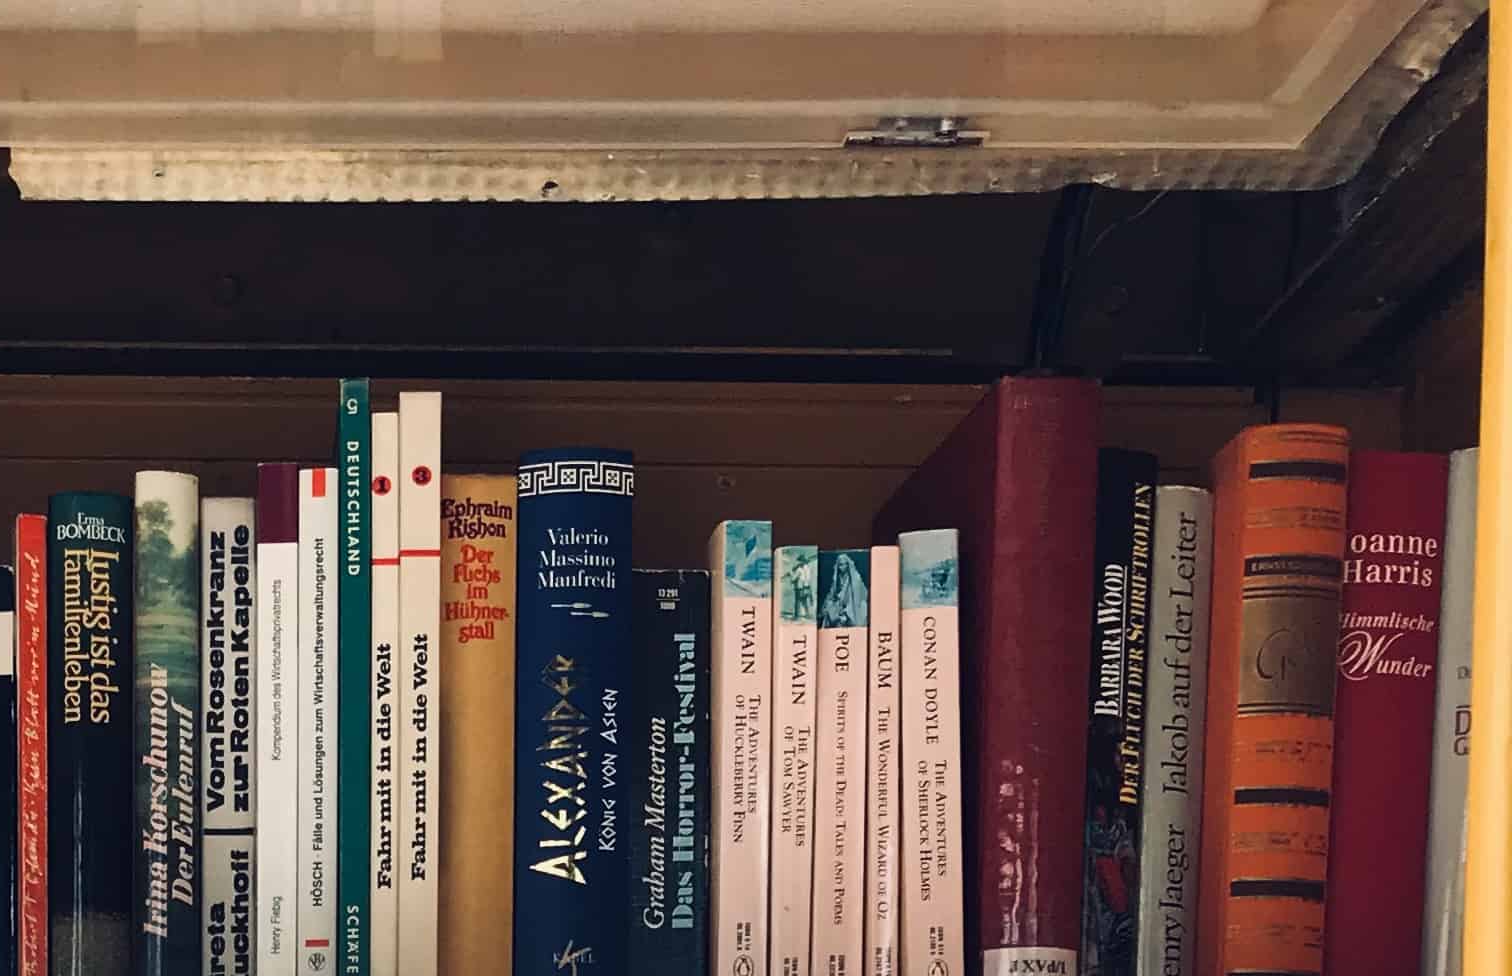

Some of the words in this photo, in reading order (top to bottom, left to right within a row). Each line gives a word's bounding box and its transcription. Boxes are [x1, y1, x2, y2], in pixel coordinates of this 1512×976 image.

[347, 440, 359, 576] DEUTSCHLAND
[546, 528, 609, 547] Valerio
[536, 549, 618, 570] Massimo
[536, 570, 617, 591] Manfredi
[1170, 513, 1198, 599] Leiter
[1342, 561, 1434, 586] Harris
[229, 525, 252, 653] Kapelle
[206, 530, 226, 729] Rosenkranz
[311, 537, 326, 706] Wirtschaftsverwaltungsrecht
[740, 605, 757, 676] TWAIN
[922, 615, 938, 681] CONAN
[1168, 605, 1194, 653] der
[411, 633, 430, 691] Welt
[790, 635, 806, 705] TWAIN
[834, 634, 851, 673] POE
[1163, 658, 1191, 708] auf
[230, 658, 250, 747] Roten
[313, 709, 324, 732] zum
[411, 696, 428, 732] die
[922, 687, 938, 744] DOYLE
[142, 660, 170, 853] Korschunow
[171, 697, 195, 843] Eulenruf
[206, 732, 225, 811] Vom
[310, 736, 326, 794] Lösungen
[411, 738, 428, 763] in
[529, 654, 589, 885] ALEXANDER
[643, 717, 666, 830] Masterton
[672, 632, 696, 862] Horror-Festival
[1161, 714, 1191, 795] Jakob
[234, 753, 250, 811] zur
[312, 798, 325, 819] und
[411, 770, 428, 815] mit
[311, 822, 325, 851] Fälle
[411, 817, 428, 881] Fahr
[143, 861, 170, 937] Irina
[172, 845, 195, 906] Der
[310, 862, 325, 907] HÖSCH
[643, 837, 668, 929] Graham
[1158, 825, 1188, 911] Jaeger
[672, 871, 696, 929] Das
